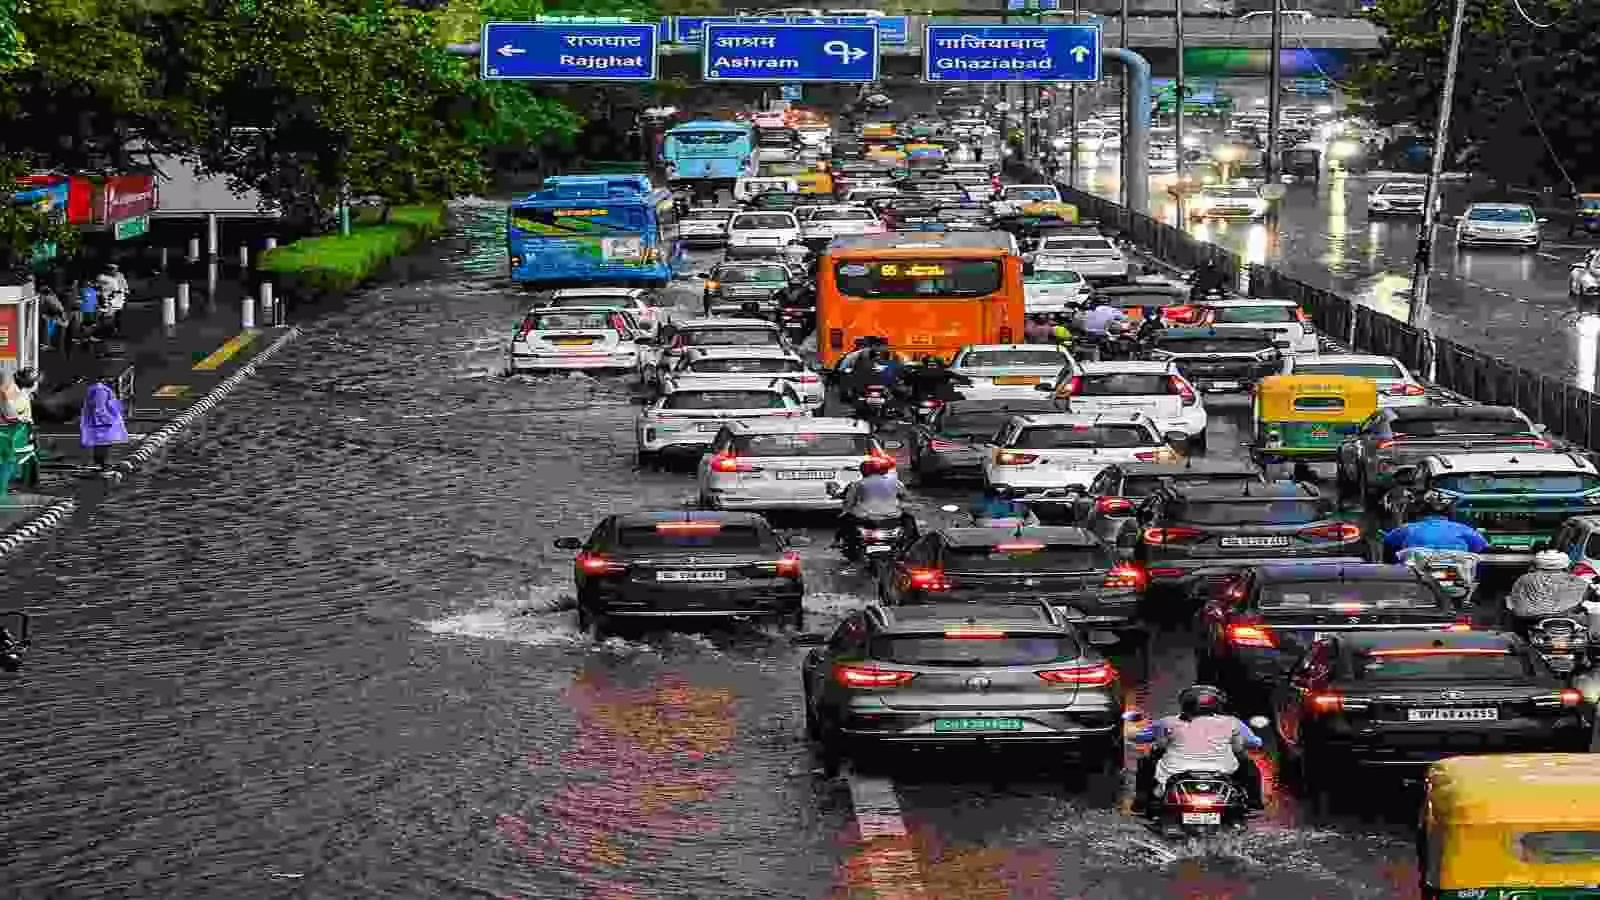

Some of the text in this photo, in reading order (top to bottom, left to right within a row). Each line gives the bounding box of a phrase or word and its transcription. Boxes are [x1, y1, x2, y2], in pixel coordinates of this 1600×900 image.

[565, 34, 641, 48] राजघाट
[716, 35, 776, 48] आश्रम
[560, 55, 642, 69] Rajghat
[714, 55, 799, 68] Ashram
[936, 55, 1053, 69] Ghaziabad
